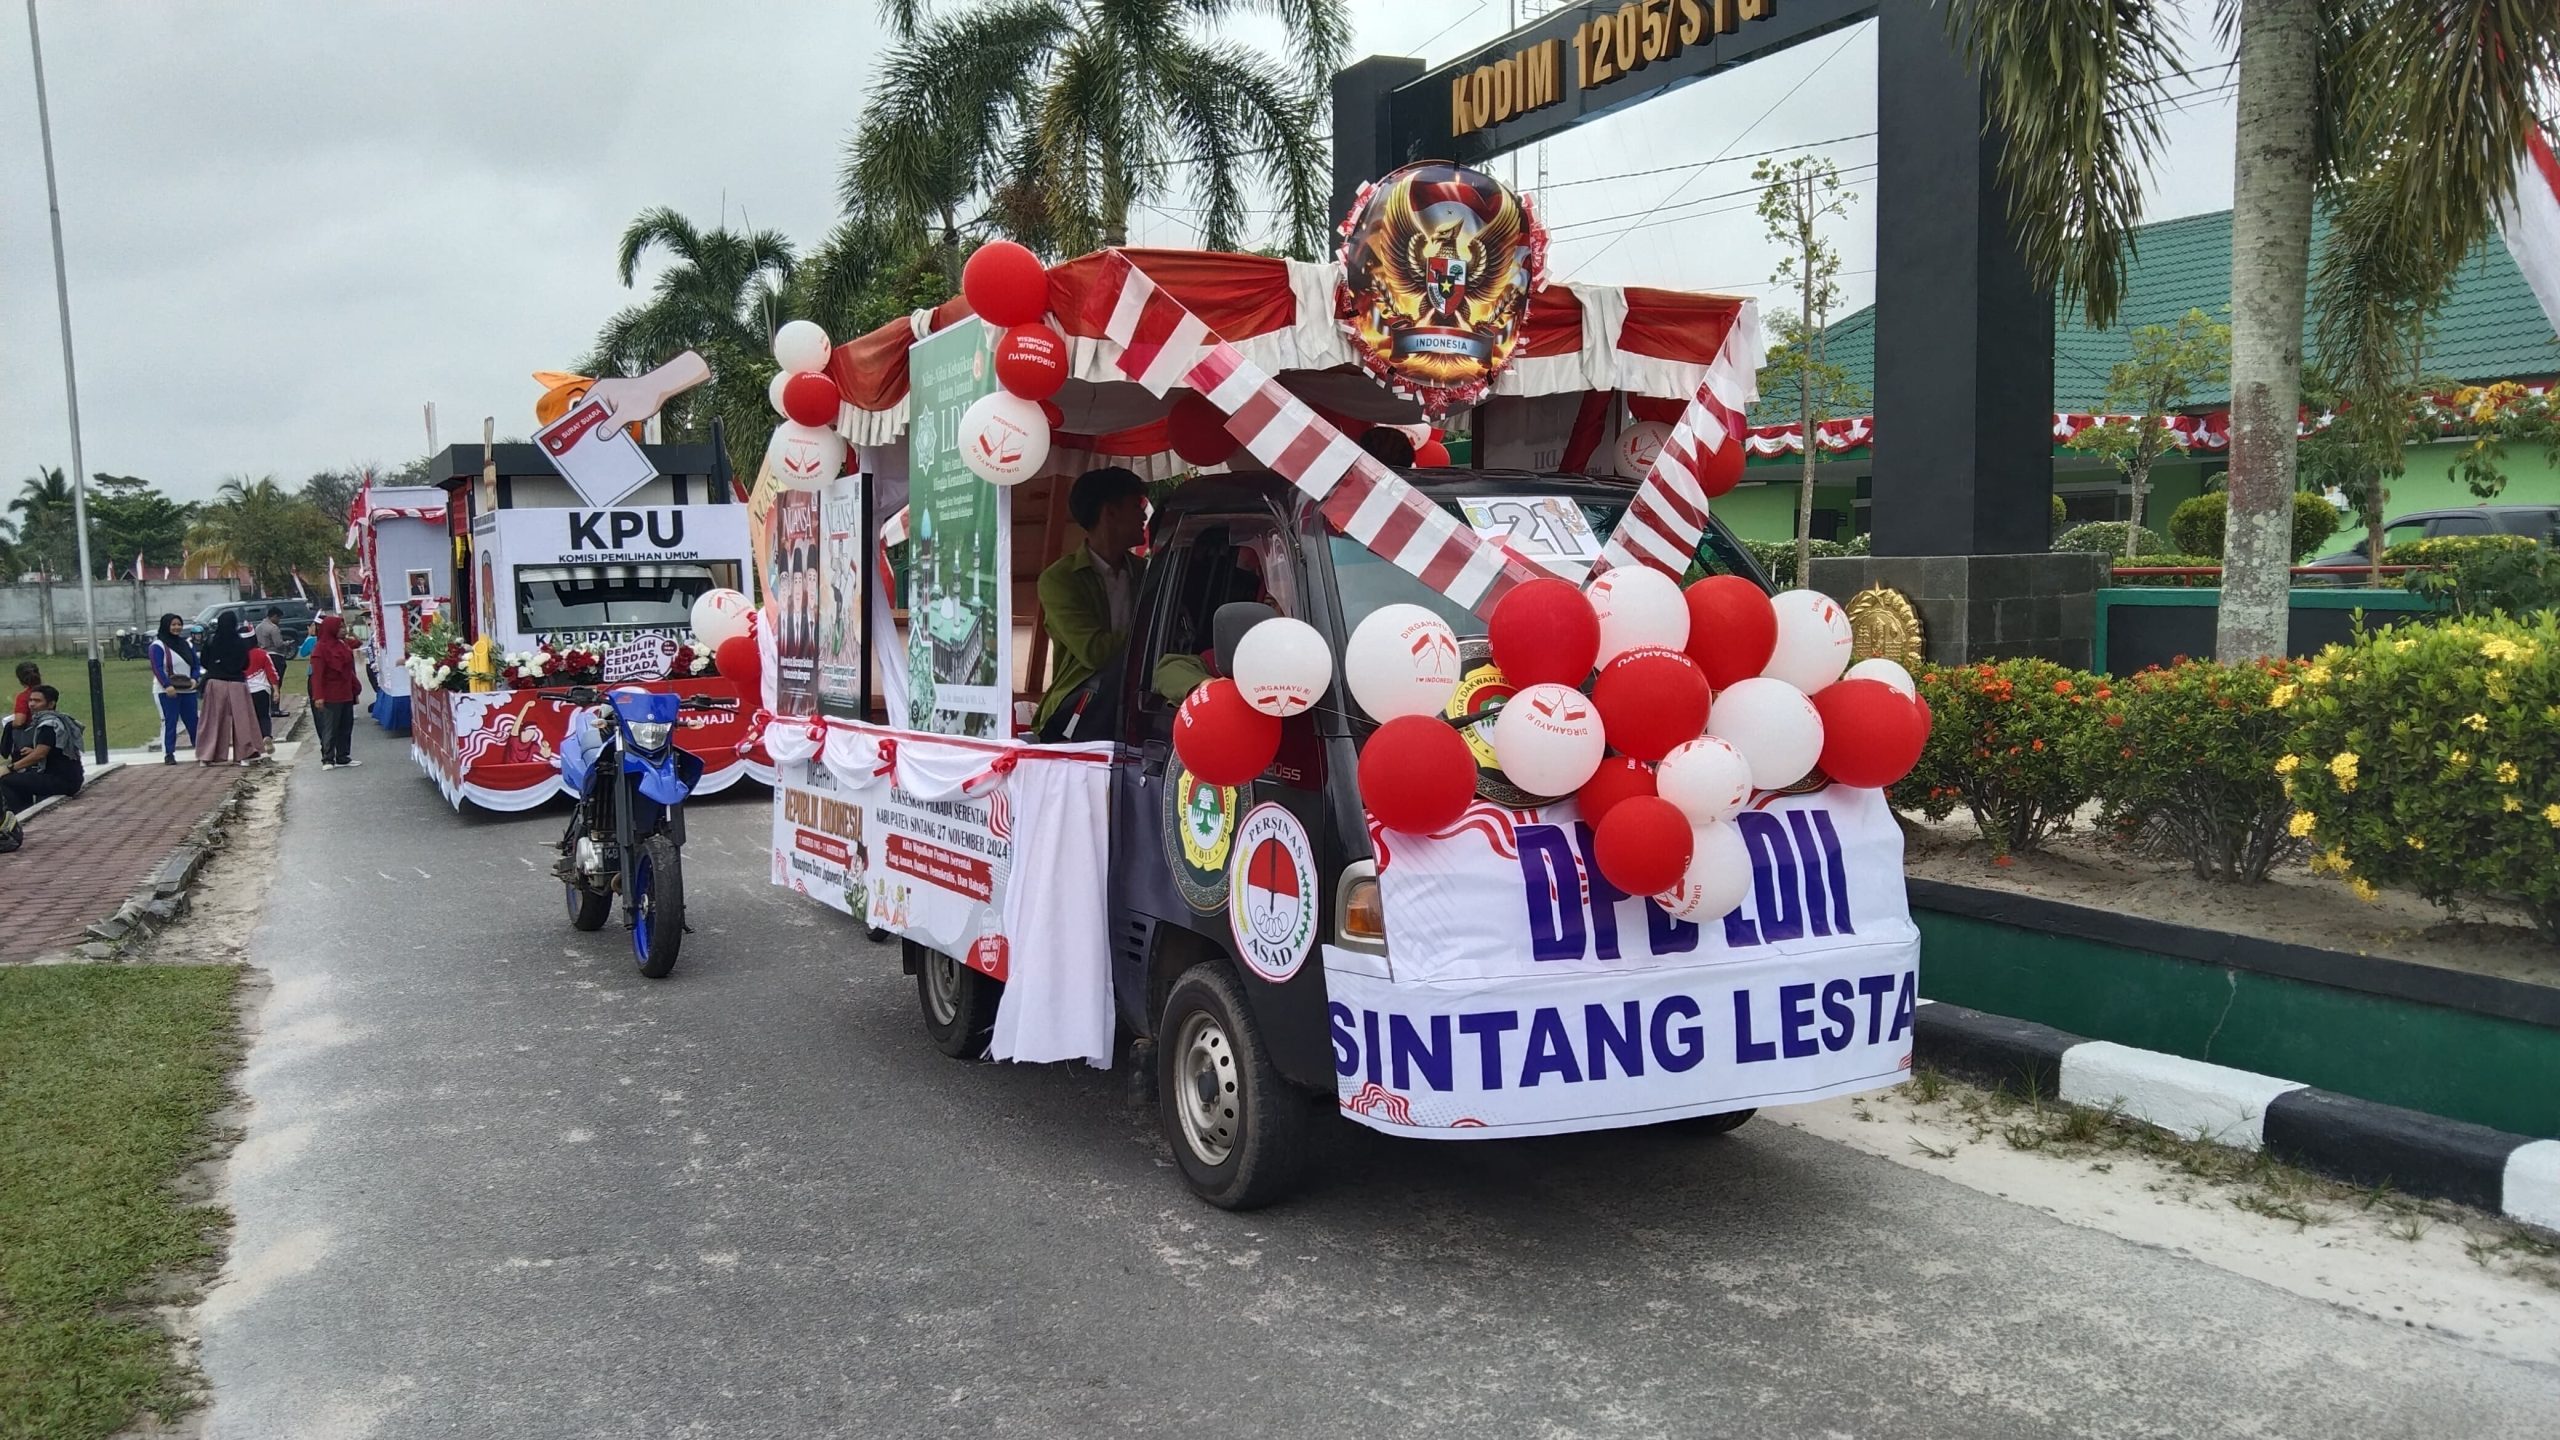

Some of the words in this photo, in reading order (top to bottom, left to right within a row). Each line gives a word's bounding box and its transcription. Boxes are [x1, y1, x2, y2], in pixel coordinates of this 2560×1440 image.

[1452, 38, 1559, 137] KODIM
[1416, 338, 1468, 350] INDONESIA
[1008, 353, 1056, 369] DIRGAHAYU
[561, 422, 581, 438] SURAT
[581, 408, 602, 425] SUARA
[941, 400, 974, 453] LD
[569, 510, 684, 550] KPU
[1488, 501, 1584, 556] 21
[558, 554, 598, 562] KOMISI
[601, 553, 662, 562] PEMILIHAN
[665, 552, 698, 560] UMUM
[1400, 618, 1448, 640] DIRGAHAYU
[606, 640, 657, 657] PEMILIH
[606, 650, 659, 666] CERDAS,
[1617, 650, 1691, 668] DIRGAHAYU
[605, 660, 659, 675] PILKADA
[1253, 684, 1302, 694] DIRGAHAYU
[1463, 676, 1496, 698] DAKWAH
[1534, 719, 1588, 736] DIRGAHAYU
[925, 800, 952, 818] PILKADA
[954, 804, 988, 828] SERENTAK
[1220, 786, 1231, 843] NDONESIA
[876, 807, 909, 831] KABUPATEN
[910, 816, 935, 838] SINTANG
[937, 824, 946, 841] 27
[948, 827, 985, 853] NOVEMBER
[987, 838, 1008, 860] 2024
[1248, 816, 1303, 860] PERSINAS
[1514, 820, 1699, 962] DP
[1248, 937, 1292, 967] ASAD
[1329, 994, 1704, 1092] SINTANG
